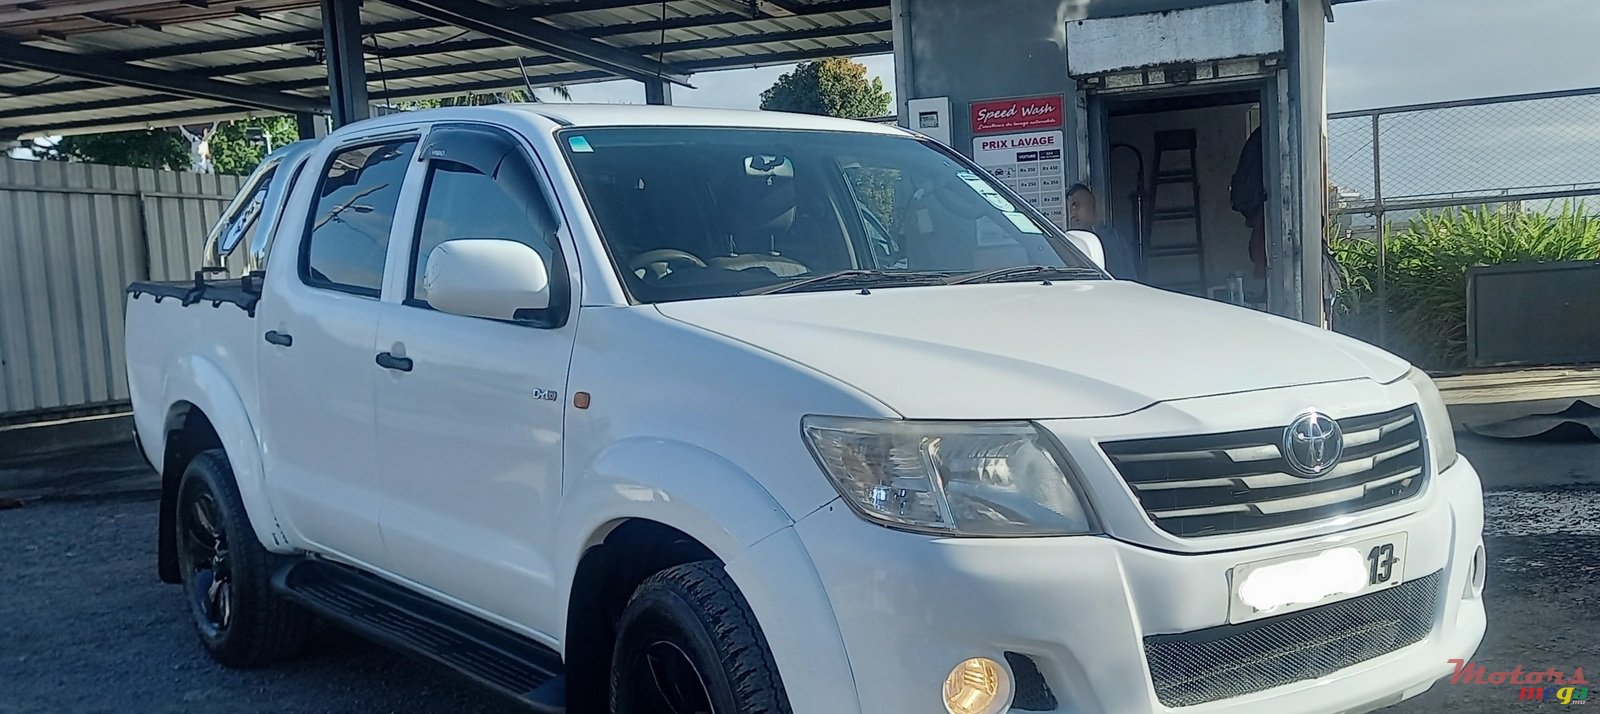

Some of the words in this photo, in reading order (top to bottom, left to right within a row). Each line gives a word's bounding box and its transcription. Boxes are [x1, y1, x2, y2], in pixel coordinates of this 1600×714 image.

[977, 104, 1017, 123] Speed
[1021, 103, 1056, 117] Wash
[982, 140, 1008, 150] PRIX
[1011, 136, 1055, 148] LAVAGE
[1367, 543, 1395, 586] 13
